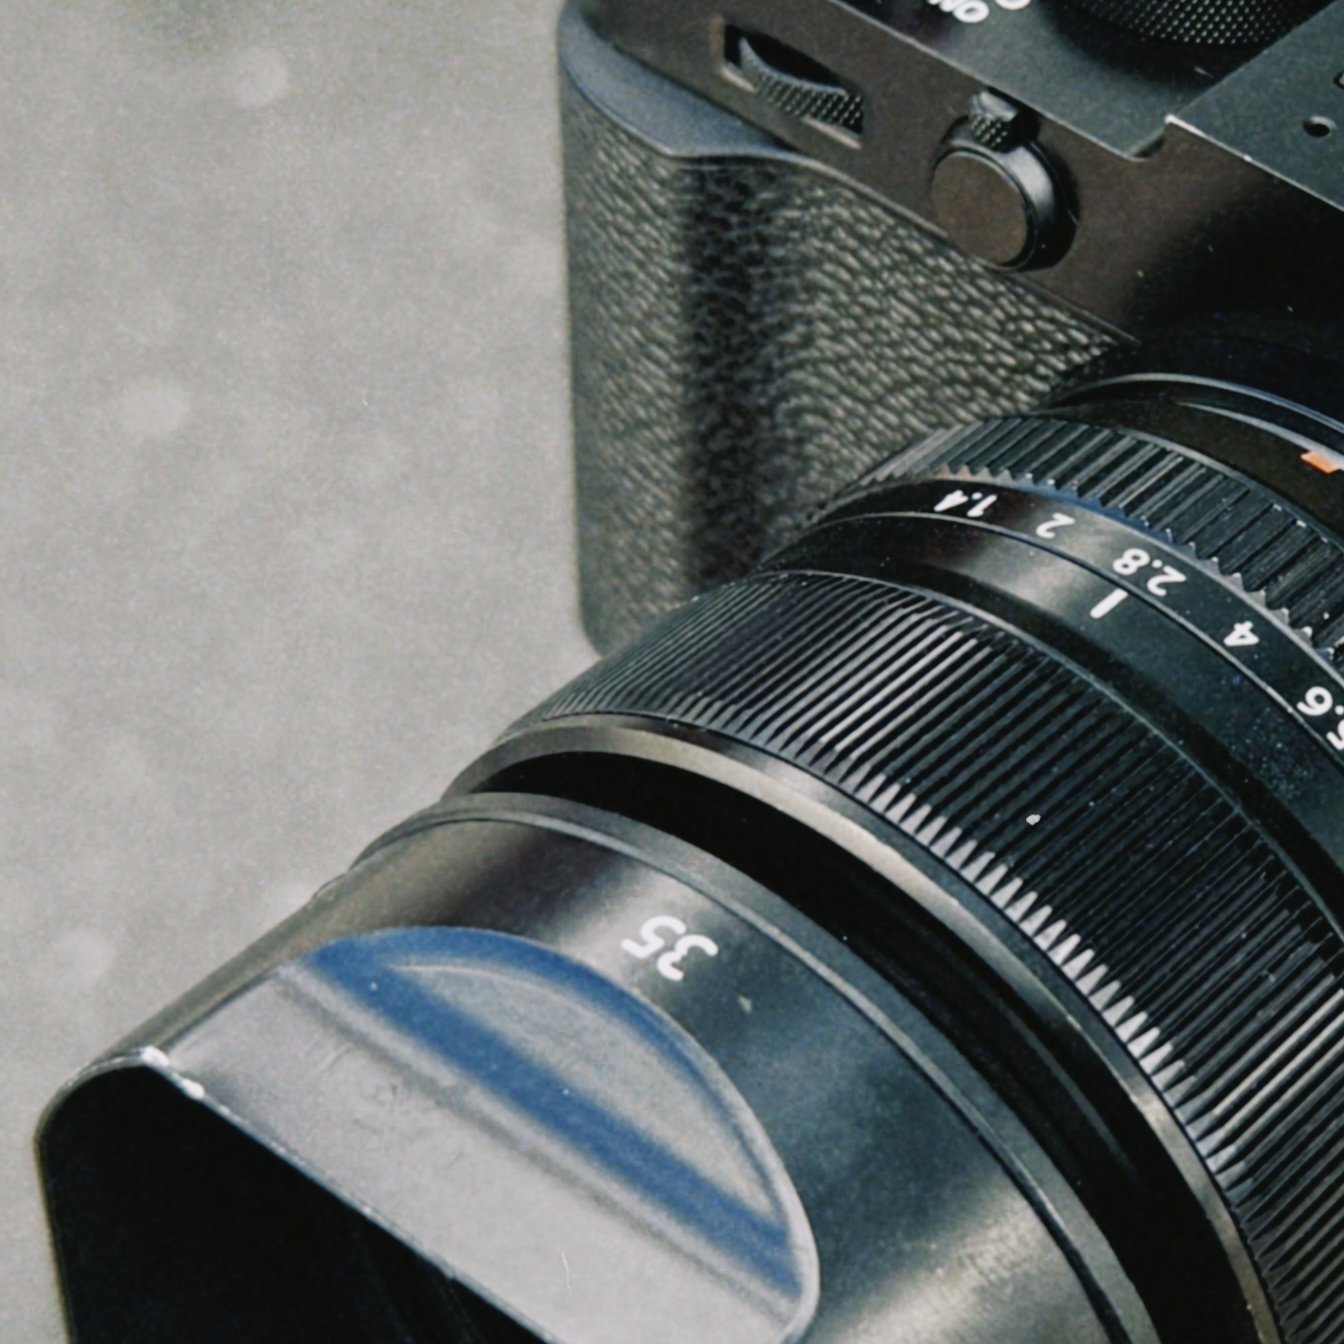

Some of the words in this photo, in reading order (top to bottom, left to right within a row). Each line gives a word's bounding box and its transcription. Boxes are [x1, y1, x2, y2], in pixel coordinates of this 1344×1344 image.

[934, 489, 997, 517] 1.4
[1036, 513, 1075, 539] 2
[1112, 548, 1187, 597] 2.8
[1223, 620, 1260, 647] 4
[621, 915, 719, 982] 35
